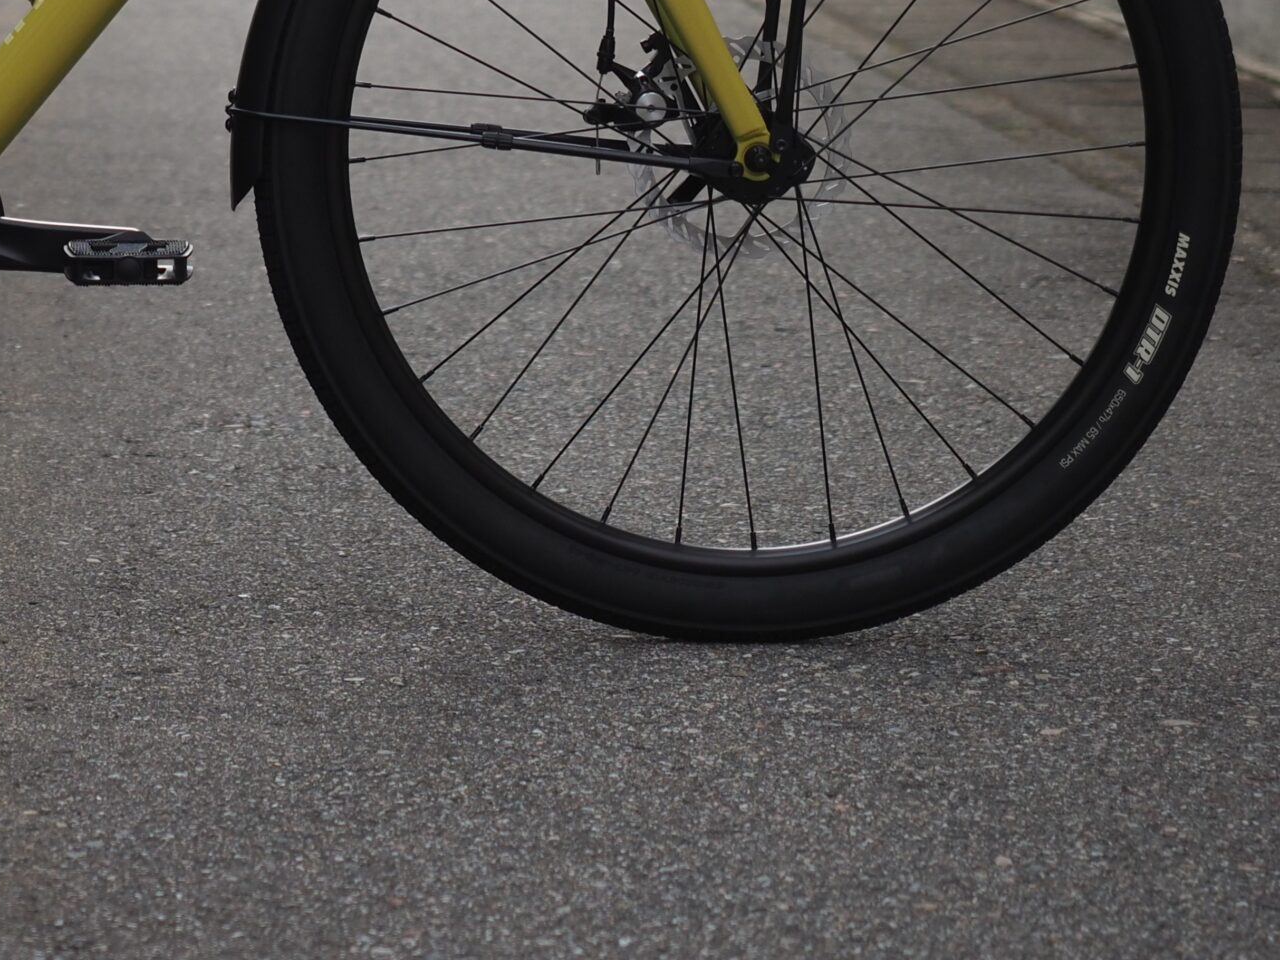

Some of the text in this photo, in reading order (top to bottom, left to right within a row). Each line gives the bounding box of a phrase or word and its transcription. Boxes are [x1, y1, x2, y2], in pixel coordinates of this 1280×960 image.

[1165, 232, 1191, 297] MAXXIS
[1123, 303, 1172, 385] DTR-1
[1099, 388, 1127, 423] 650x47b
[1086, 427, 1099, 440] 65
[1070, 438, 1090, 457] MAX
[1059, 454, 1074, 469] PSI
